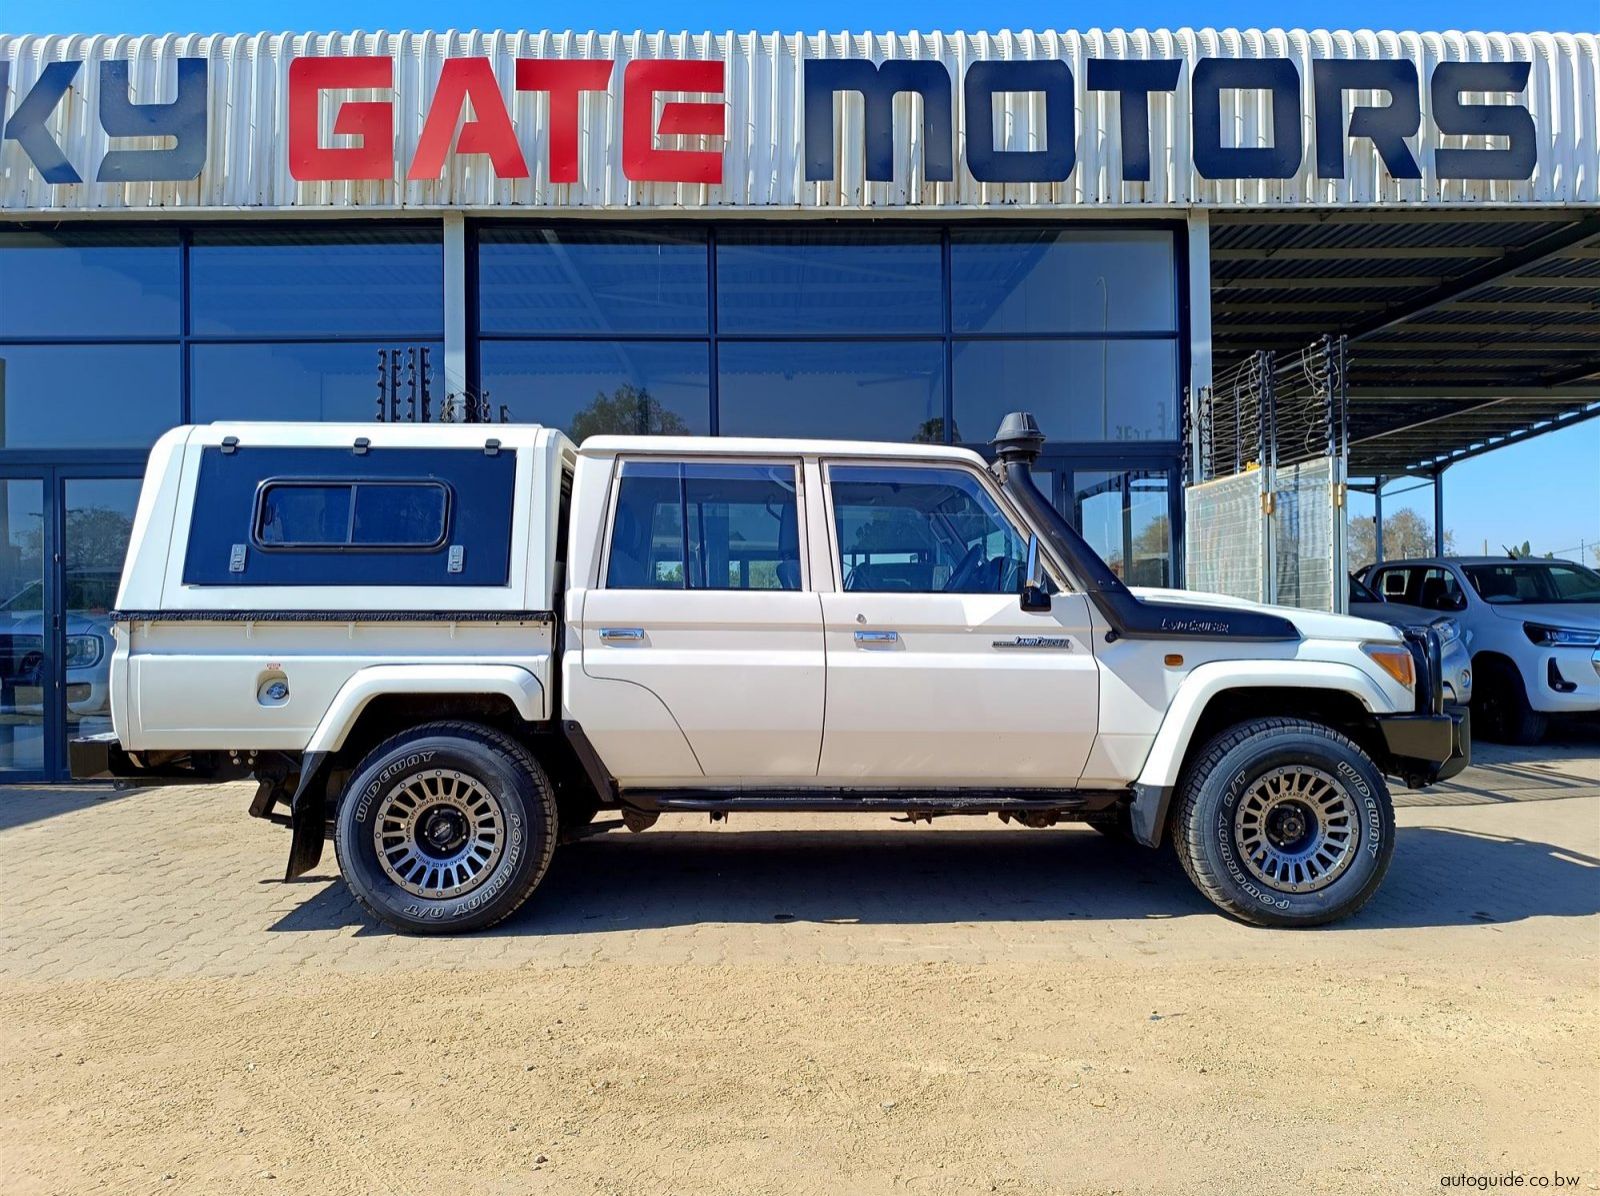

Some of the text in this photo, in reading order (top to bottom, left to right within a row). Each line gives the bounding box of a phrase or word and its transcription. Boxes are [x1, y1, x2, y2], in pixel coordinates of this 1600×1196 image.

[288, 56, 725, 184] GATE
[804, 57, 1538, 183] MOTORS
[355, 751, 436, 823] WIDEWAY
[1337, 760, 1382, 859] WIDEWAY
